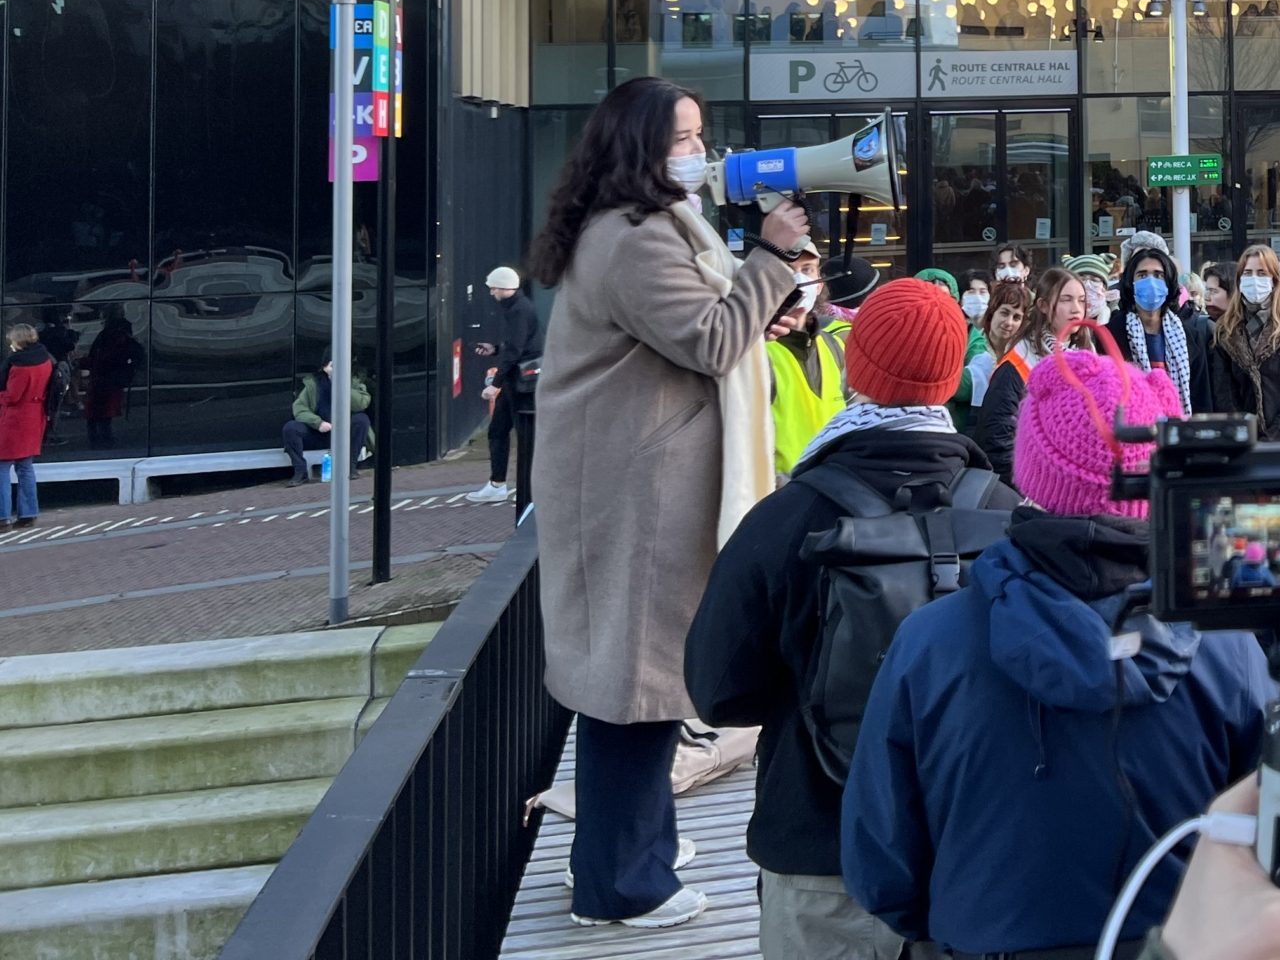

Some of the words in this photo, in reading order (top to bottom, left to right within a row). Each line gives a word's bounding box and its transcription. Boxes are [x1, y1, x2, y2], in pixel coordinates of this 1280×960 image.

[355, 20, 373, 33] EA
[379, 9, 387, 38] D
[379, 54, 387, 84] E
[789, 60, 816, 93] P
[951, 63, 988, 72] ROUTE
[990, 62, 1046, 72] CENTRALE
[1049, 62, 1070, 71] HAL
[951, 76, 986, 85] ROUTE
[989, 75, 1035, 85] CENTRAL
[1037, 75, 1064, 84] HALL
[379, 99, 387, 129] H
